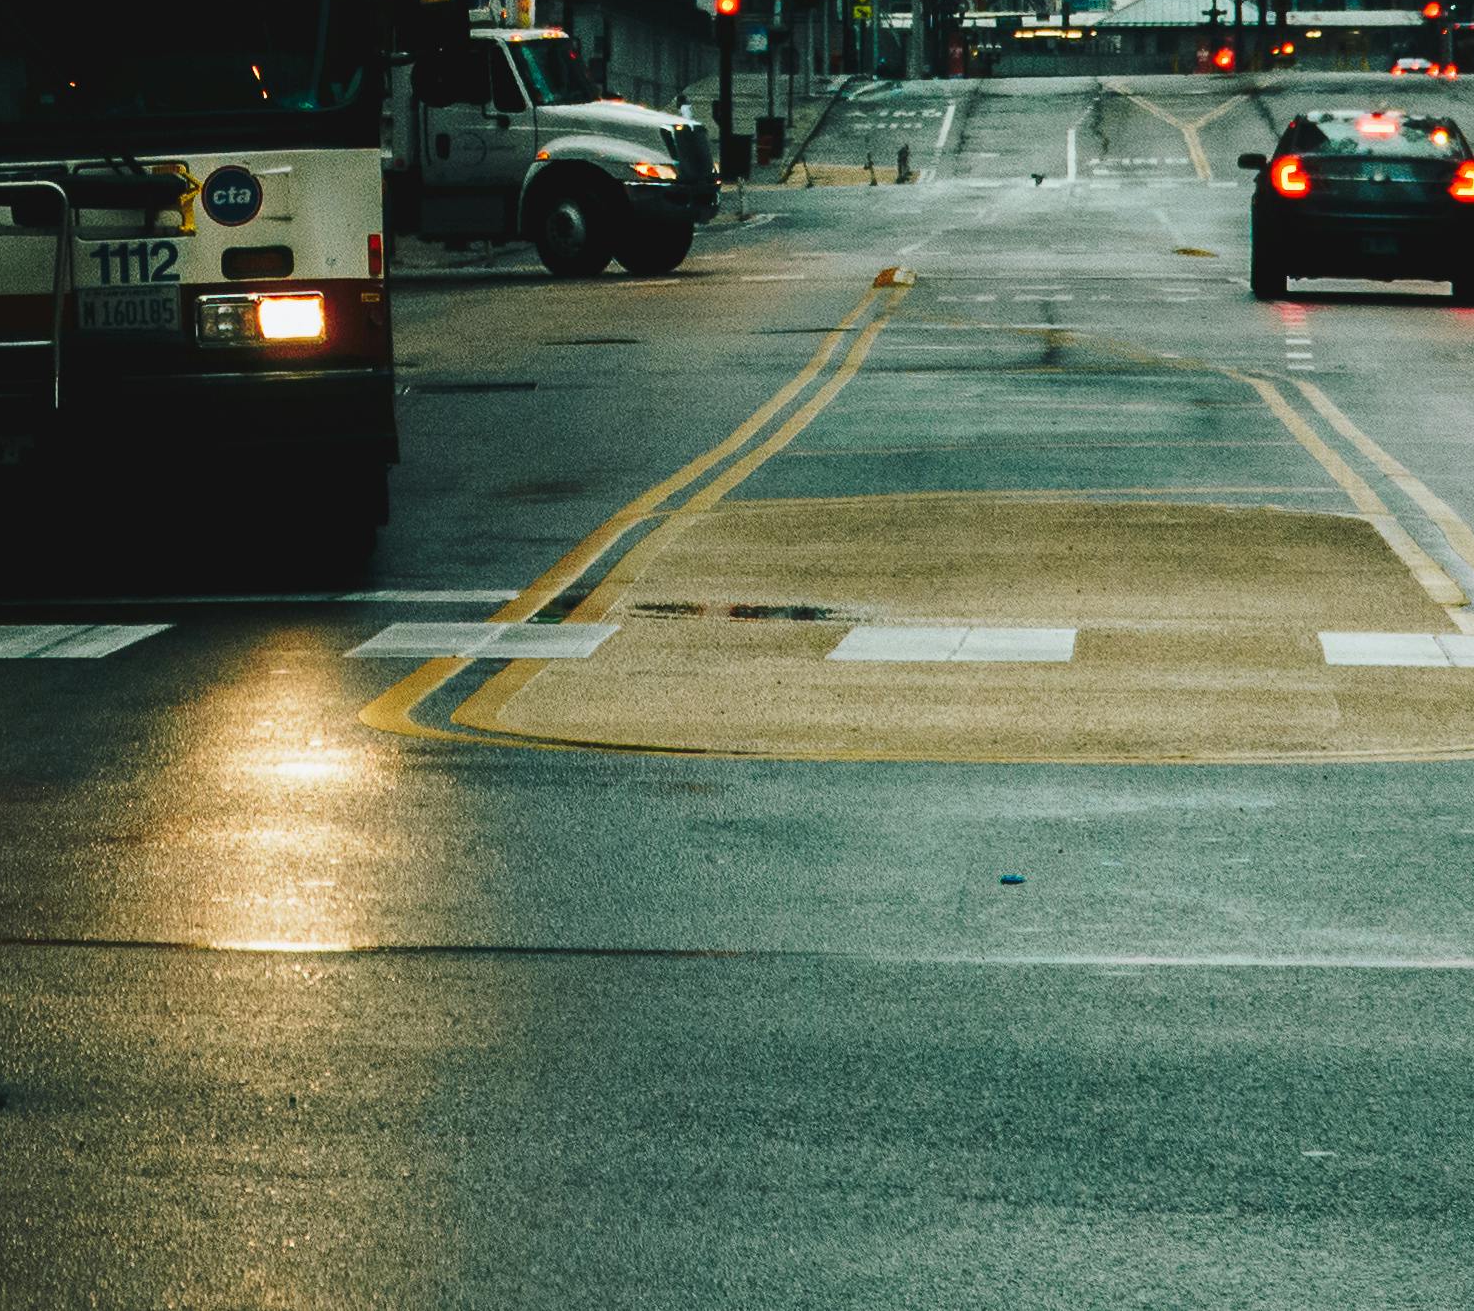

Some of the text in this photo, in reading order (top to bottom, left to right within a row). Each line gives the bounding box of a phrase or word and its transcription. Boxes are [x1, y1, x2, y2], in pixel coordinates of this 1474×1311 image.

[211, 184, 253, 206] cta
[91, 241, 180, 283] 1112
[103, 298, 176, 327] 160185
